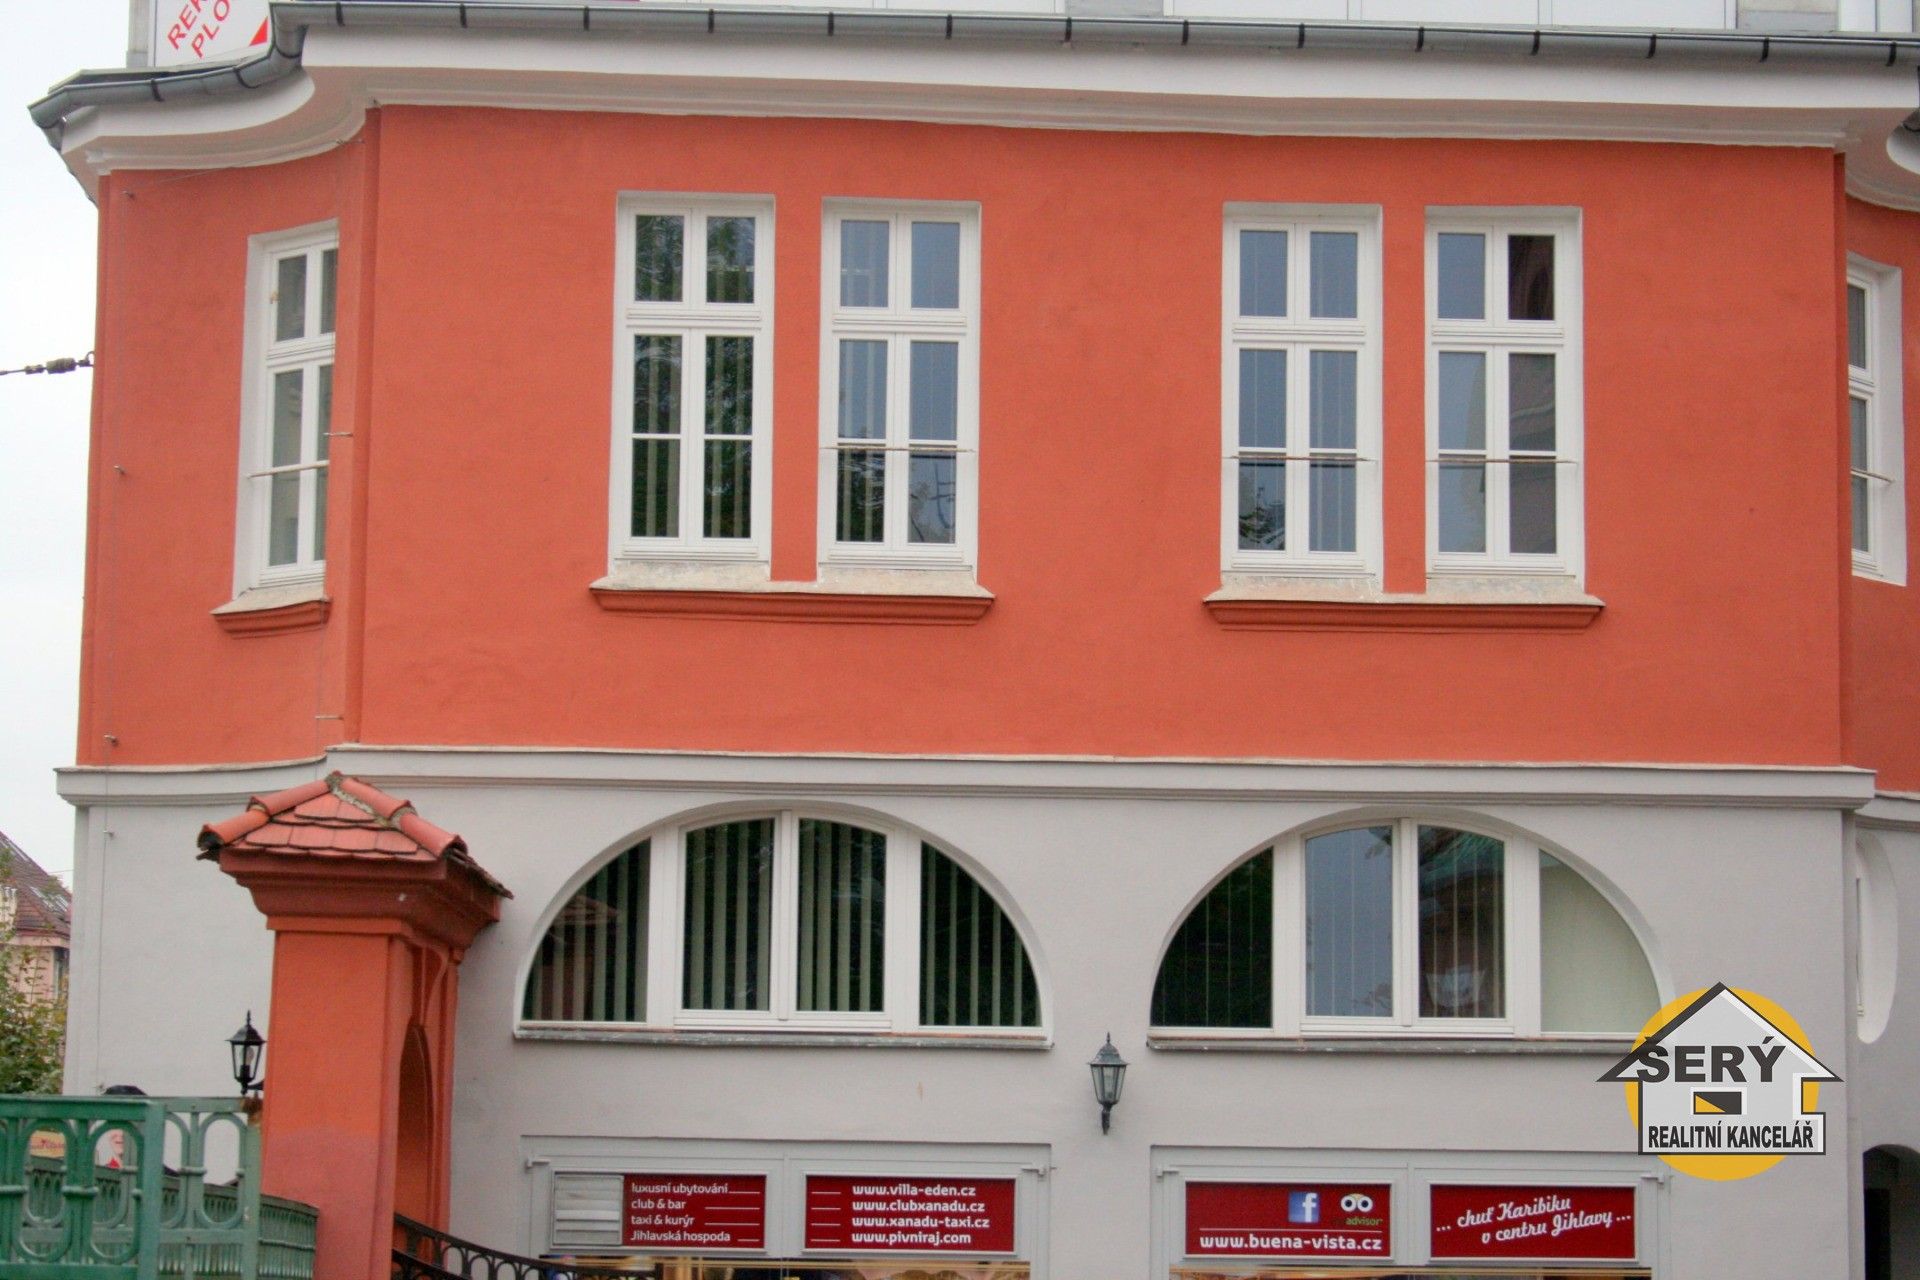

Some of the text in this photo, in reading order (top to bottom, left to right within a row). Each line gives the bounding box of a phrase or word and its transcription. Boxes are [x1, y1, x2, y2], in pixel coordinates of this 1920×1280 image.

[631, 1182, 728, 1196] luxusní ubytování
[852, 1184, 976, 1196] www.villa-eden.cz
[631, 1199, 686, 1209] club & bar
[852, 1199, 985, 1212] www.clubxanadu.cz
[1496, 1194, 1571, 1221] Karibiku
[631, 1214, 695, 1227] taxi & kurýr
[851, 1215, 990, 1228] www.xanadu-taxi.cz
[1495, 1222, 1547, 1242] centru
[1550, 1210, 1613, 1237] Jihlavy
[630, 1230, 730, 1244] Jihlavská hospoda
[851, 1231, 971, 1245] www.pivniraj.com
[1200, 1233, 1382, 1250] www.buena-vista.cz
